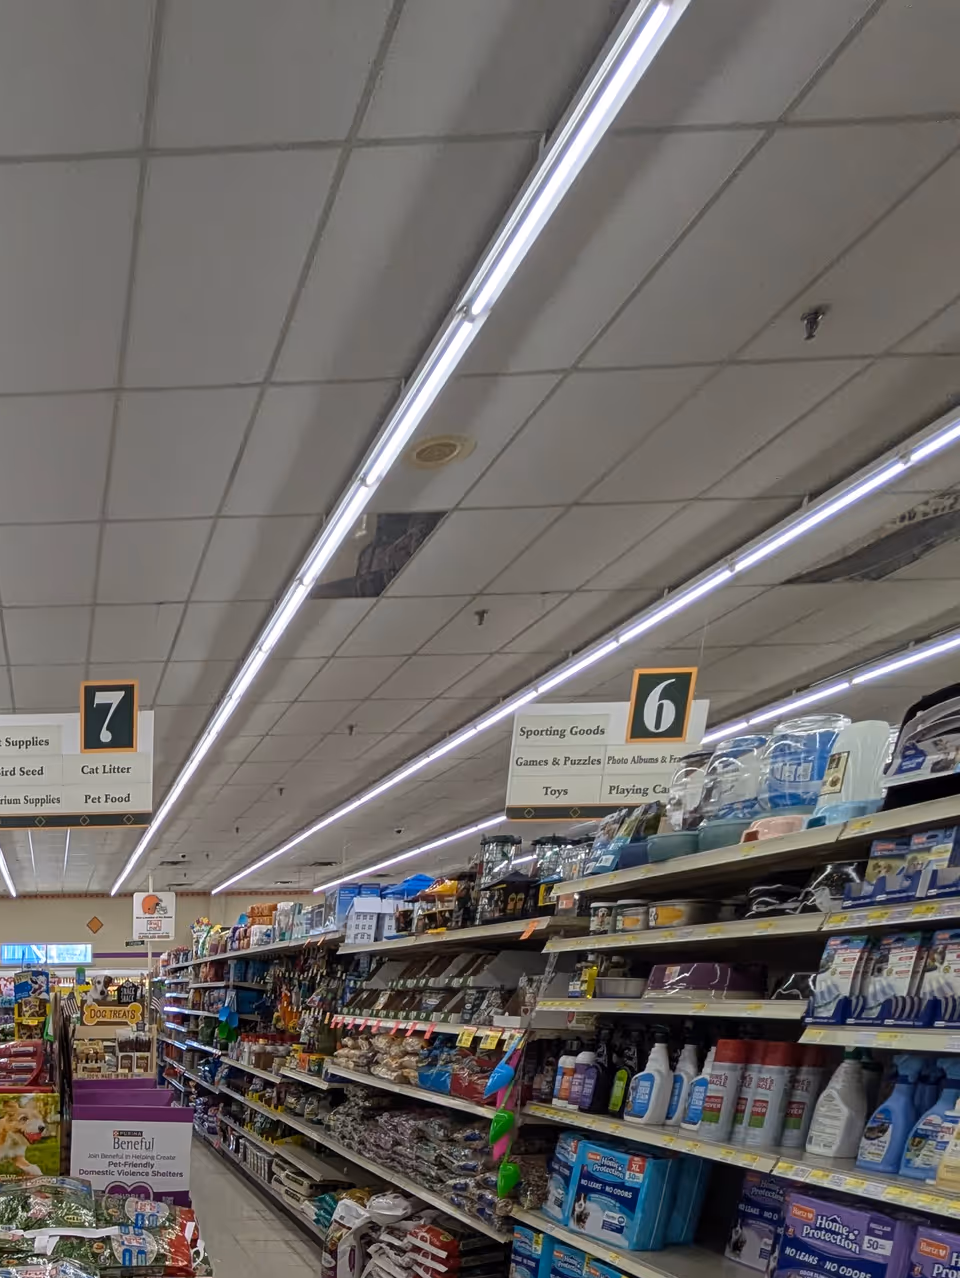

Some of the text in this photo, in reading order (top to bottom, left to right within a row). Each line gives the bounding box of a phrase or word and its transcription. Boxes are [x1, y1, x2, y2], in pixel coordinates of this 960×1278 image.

[643, 678, 676, 734] 6
[93, 690, 126, 743] 7
[519, 725, 605, 738] Sporting Goods
[4, 736, 50, 749] Supplies
[515, 755, 602, 767] Games & Puzzles
[607, 755, 629, 765] Photo
[630, 754, 659, 765] Albums
[19, 765, 44, 776] Seed
[81, 764, 132, 775] Cat Litter
[542, 786, 568, 799] Toys
[608, 785, 649, 797] Playing
[23, 794, 61, 807] Supplies
[84, 793, 131, 804] Pet Food
[90, 1008, 136, 1019] DOG TREATS
[112, 1136, 155, 1151] Beneful
[107, 1160, 155, 1169] Pet-Friendly
[631, 1163, 640, 1172] XL
[117, 1169, 150, 1177] Violence
[580, 1178, 633, 1199] NO LEAKS NO ODORS
[816, 1215, 850, 1236] Home
[802, 1225, 860, 1254] Protection
[866, 1238, 879, 1250] 50
[784, 1246, 796, 1259] NO
[796, 1248, 819, 1265] LEAKS
[824, 1260, 838, 1273] NO
